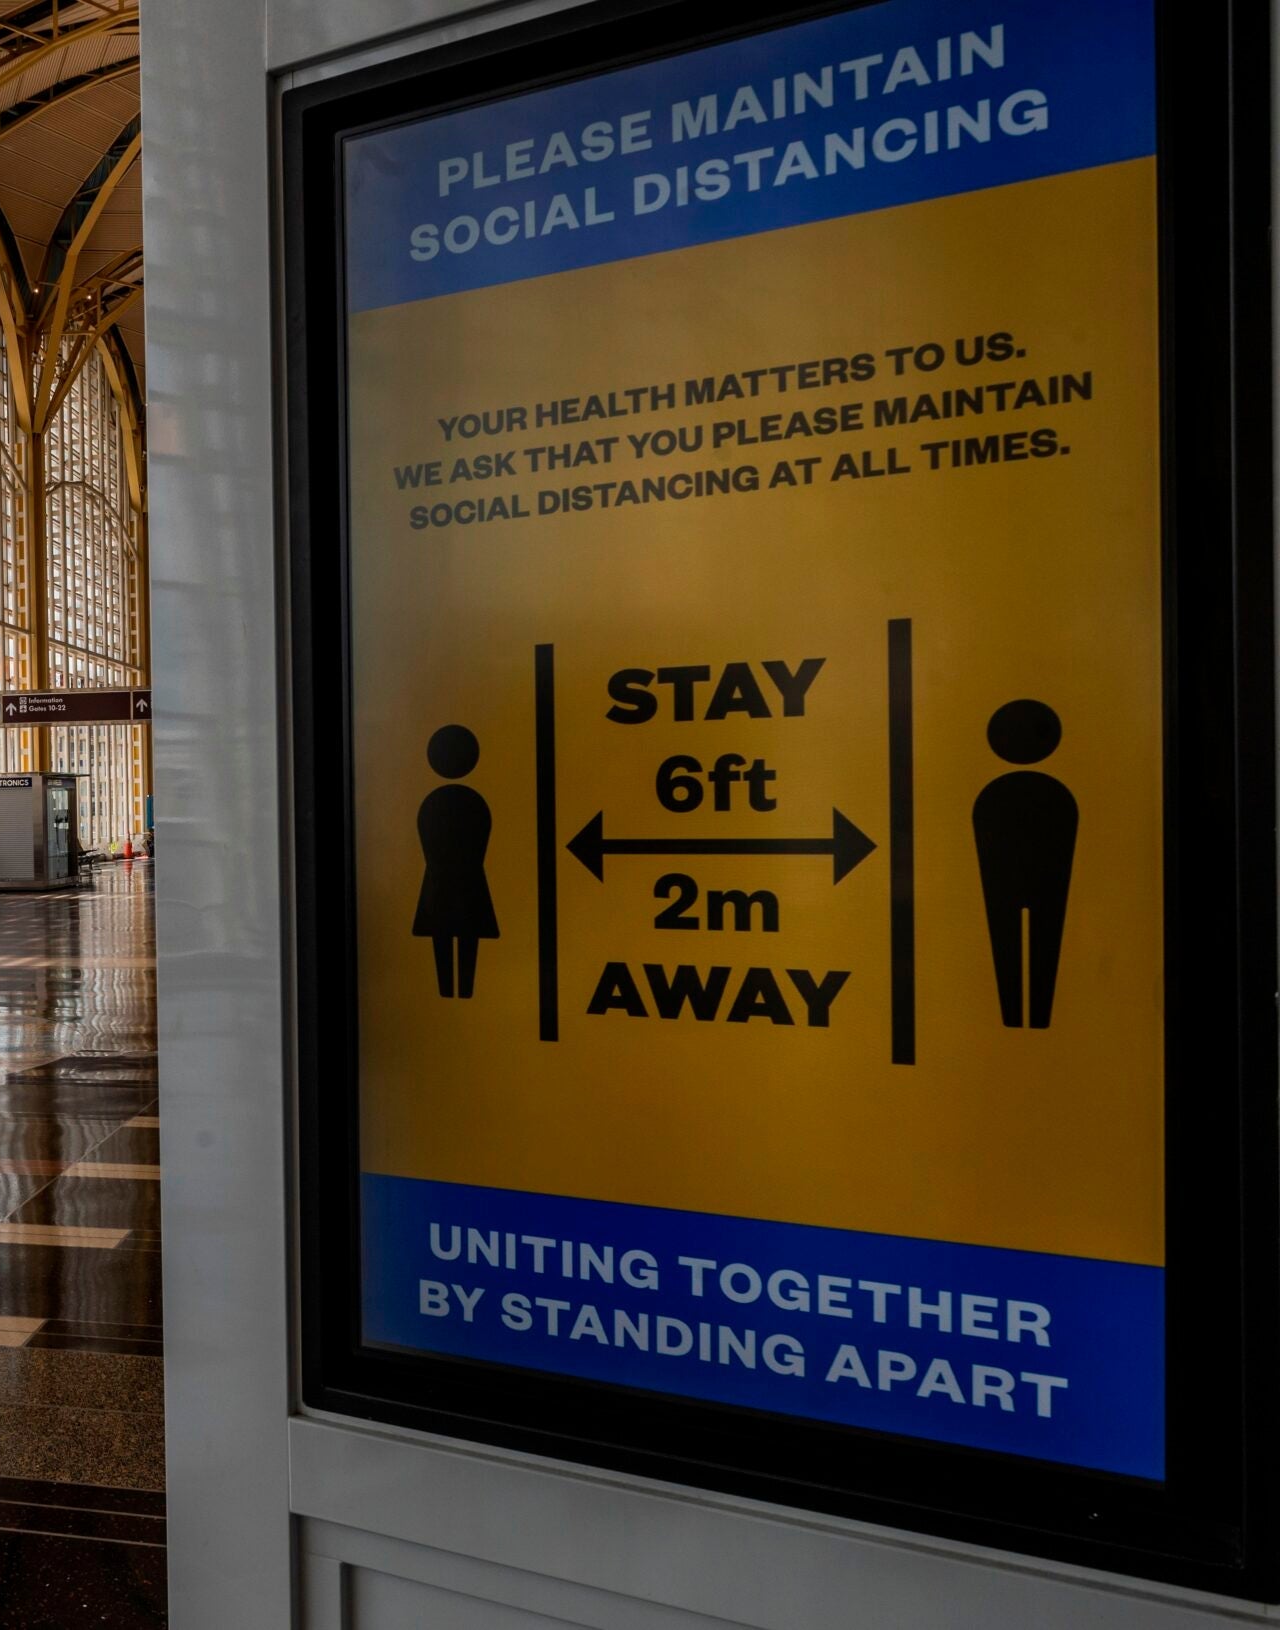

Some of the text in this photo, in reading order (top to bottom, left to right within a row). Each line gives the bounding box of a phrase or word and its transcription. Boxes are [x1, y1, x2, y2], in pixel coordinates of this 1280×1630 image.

[439, 24, 1005, 196] PLEASE MAINTAIN
[410, 89, 1049, 261] SOCIAL DISTANCING
[394, 371, 1093, 489] WE ASK THAT YOU PLEASE MAINTAIN
[438, 332, 1026, 441] YOUR HEALTH MATTERS TO US.
[409, 428, 1071, 530] SOCIAL DISTANCING AT ALL TIMES.
[606, 658, 826, 725] STAY
[656, 753, 777, 813] 6ft
[654, 873, 779, 932] 2m
[586, 962, 851, 1028] AWAY
[429, 1223, 1052, 1347] UNITING TOGETHER
[419, 1278, 1070, 1418] BY STANDING APART
